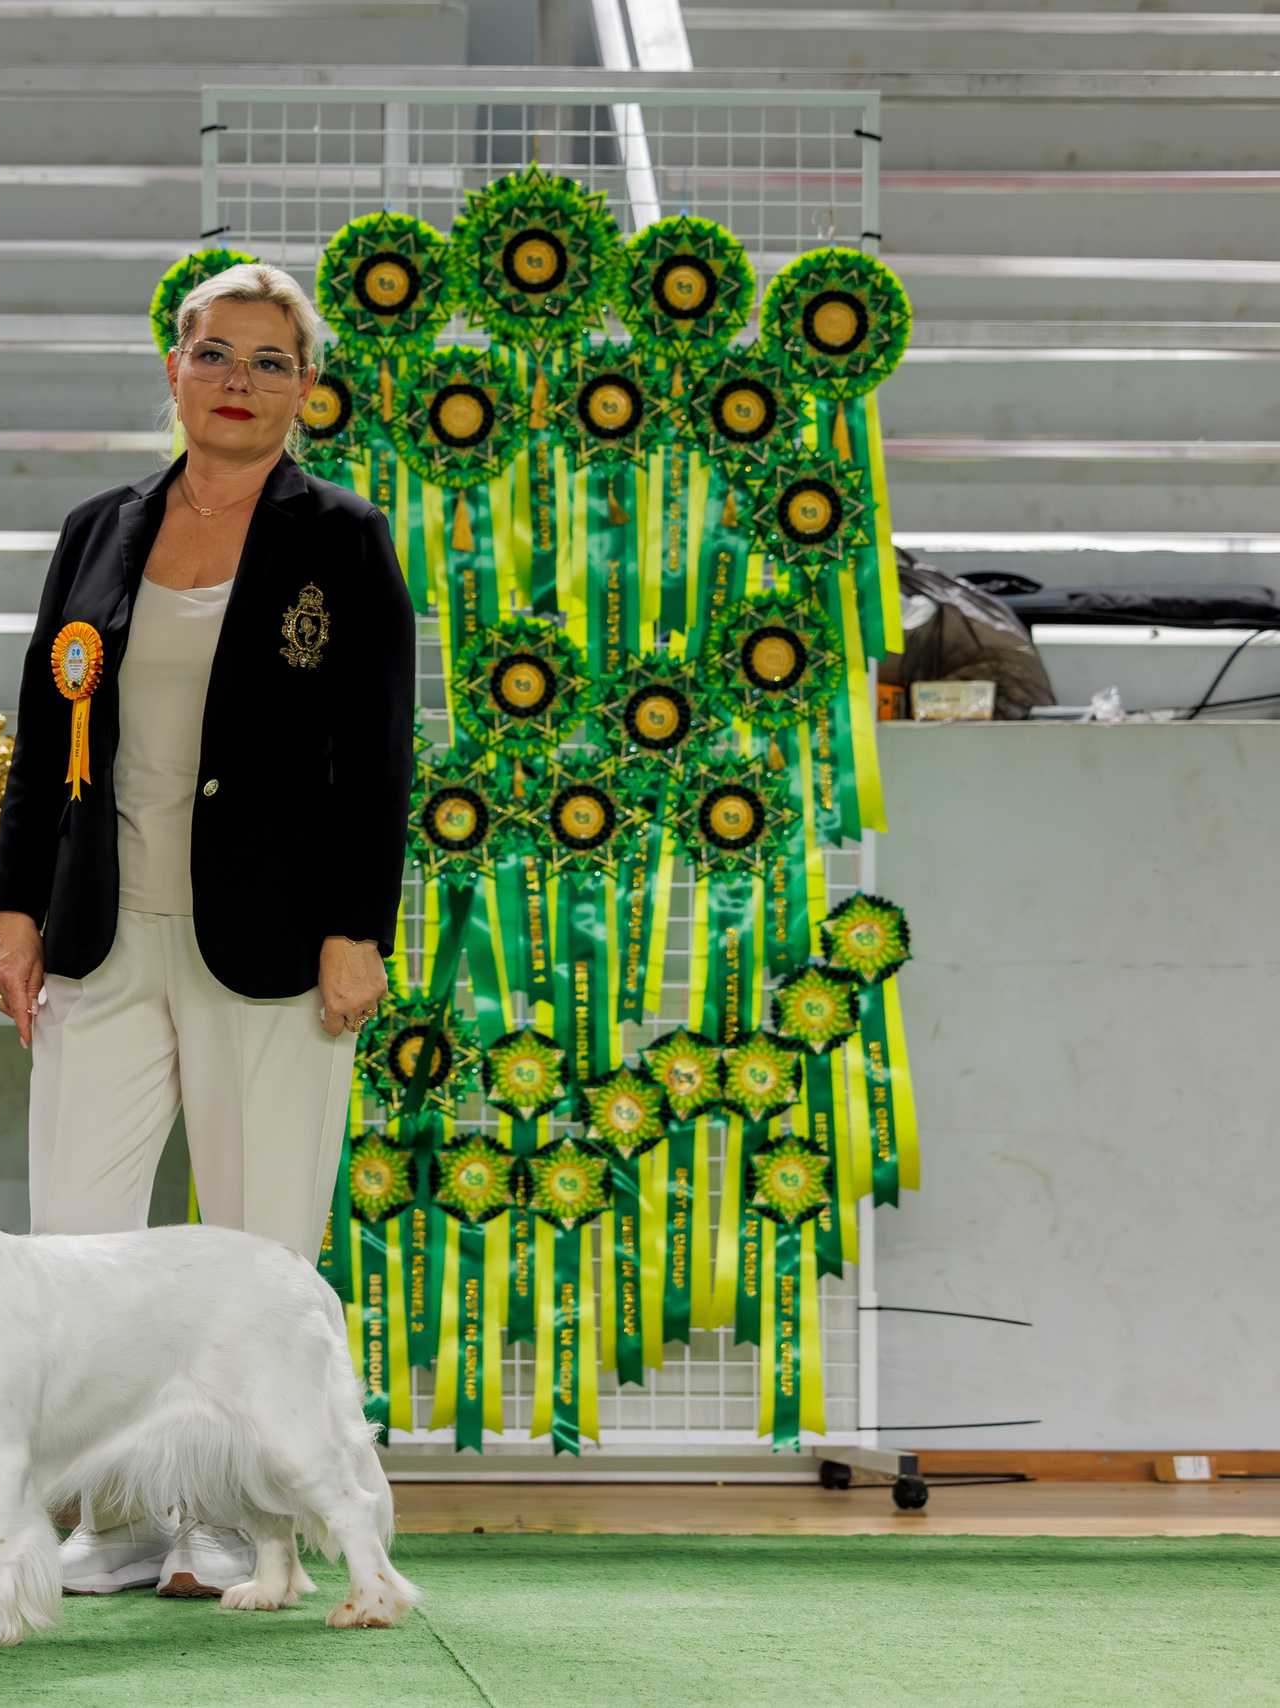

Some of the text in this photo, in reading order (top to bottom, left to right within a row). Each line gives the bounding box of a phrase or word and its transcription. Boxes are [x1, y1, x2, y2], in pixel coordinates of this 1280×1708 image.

[538, 485, 550, 501] IN
[75, 711, 83, 758] JUDGE
[527, 895, 546, 970] HANDLER
[626, 942, 641, 991] SHOW
[533, 974, 546, 983] 1
[574, 961, 588, 1080] BEST HANDLER
[814, 1112, 828, 1151] BEST
[868, 1041, 891, 1162] BEST IN GROUP
[515, 1220, 529, 1238] IN
[672, 1167, 688, 1288] BEST IN GROUP
[745, 1219, 759, 1237] IN
[411, 1208, 426, 1332] BEST KENNEL 2
[515, 1242, 528, 1297] GROUP
[621, 1215, 635, 1337] BEST IN GROUP
[743, 1241, 759, 1297] GROUP
[368, 1273, 383, 1395] BEST IN GROUP
[464, 1278, 479, 1400] BEST IN GROUP
[559, 1283, 574, 1405] BEST IN GROUP
[780, 1275, 794, 1397] BEST IN GROUP
